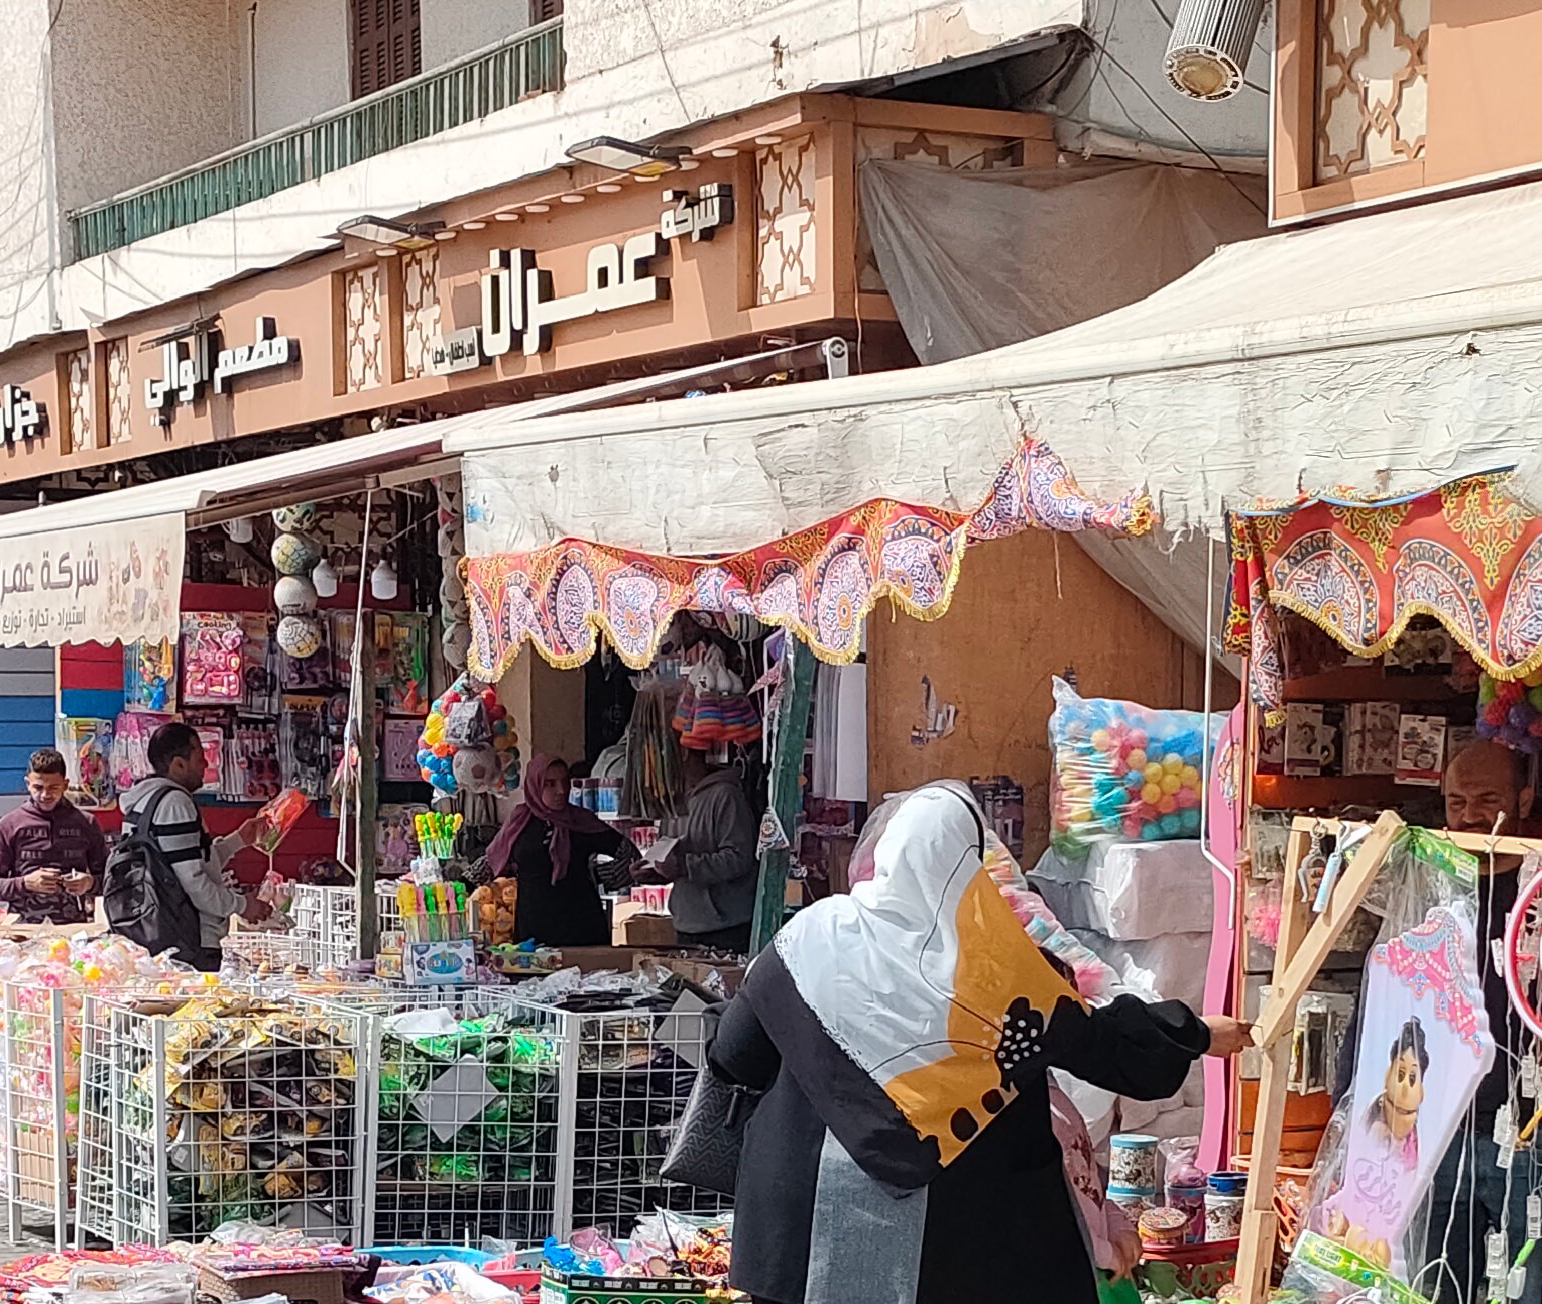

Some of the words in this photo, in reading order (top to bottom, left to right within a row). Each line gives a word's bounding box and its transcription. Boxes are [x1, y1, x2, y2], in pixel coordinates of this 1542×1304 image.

[661, 183, 722, 243] شركة
[481, 231, 658, 358] عمران
[144, 329, 209, 427] الوالي
[214, 316, 289, 394] مطعم
[41, 541, 99, 600] شركة
[2, 610, 22, 635] توزيع
[29, 609, 49, 634] تجارة
[57, 606, 86, 634] استيراد
